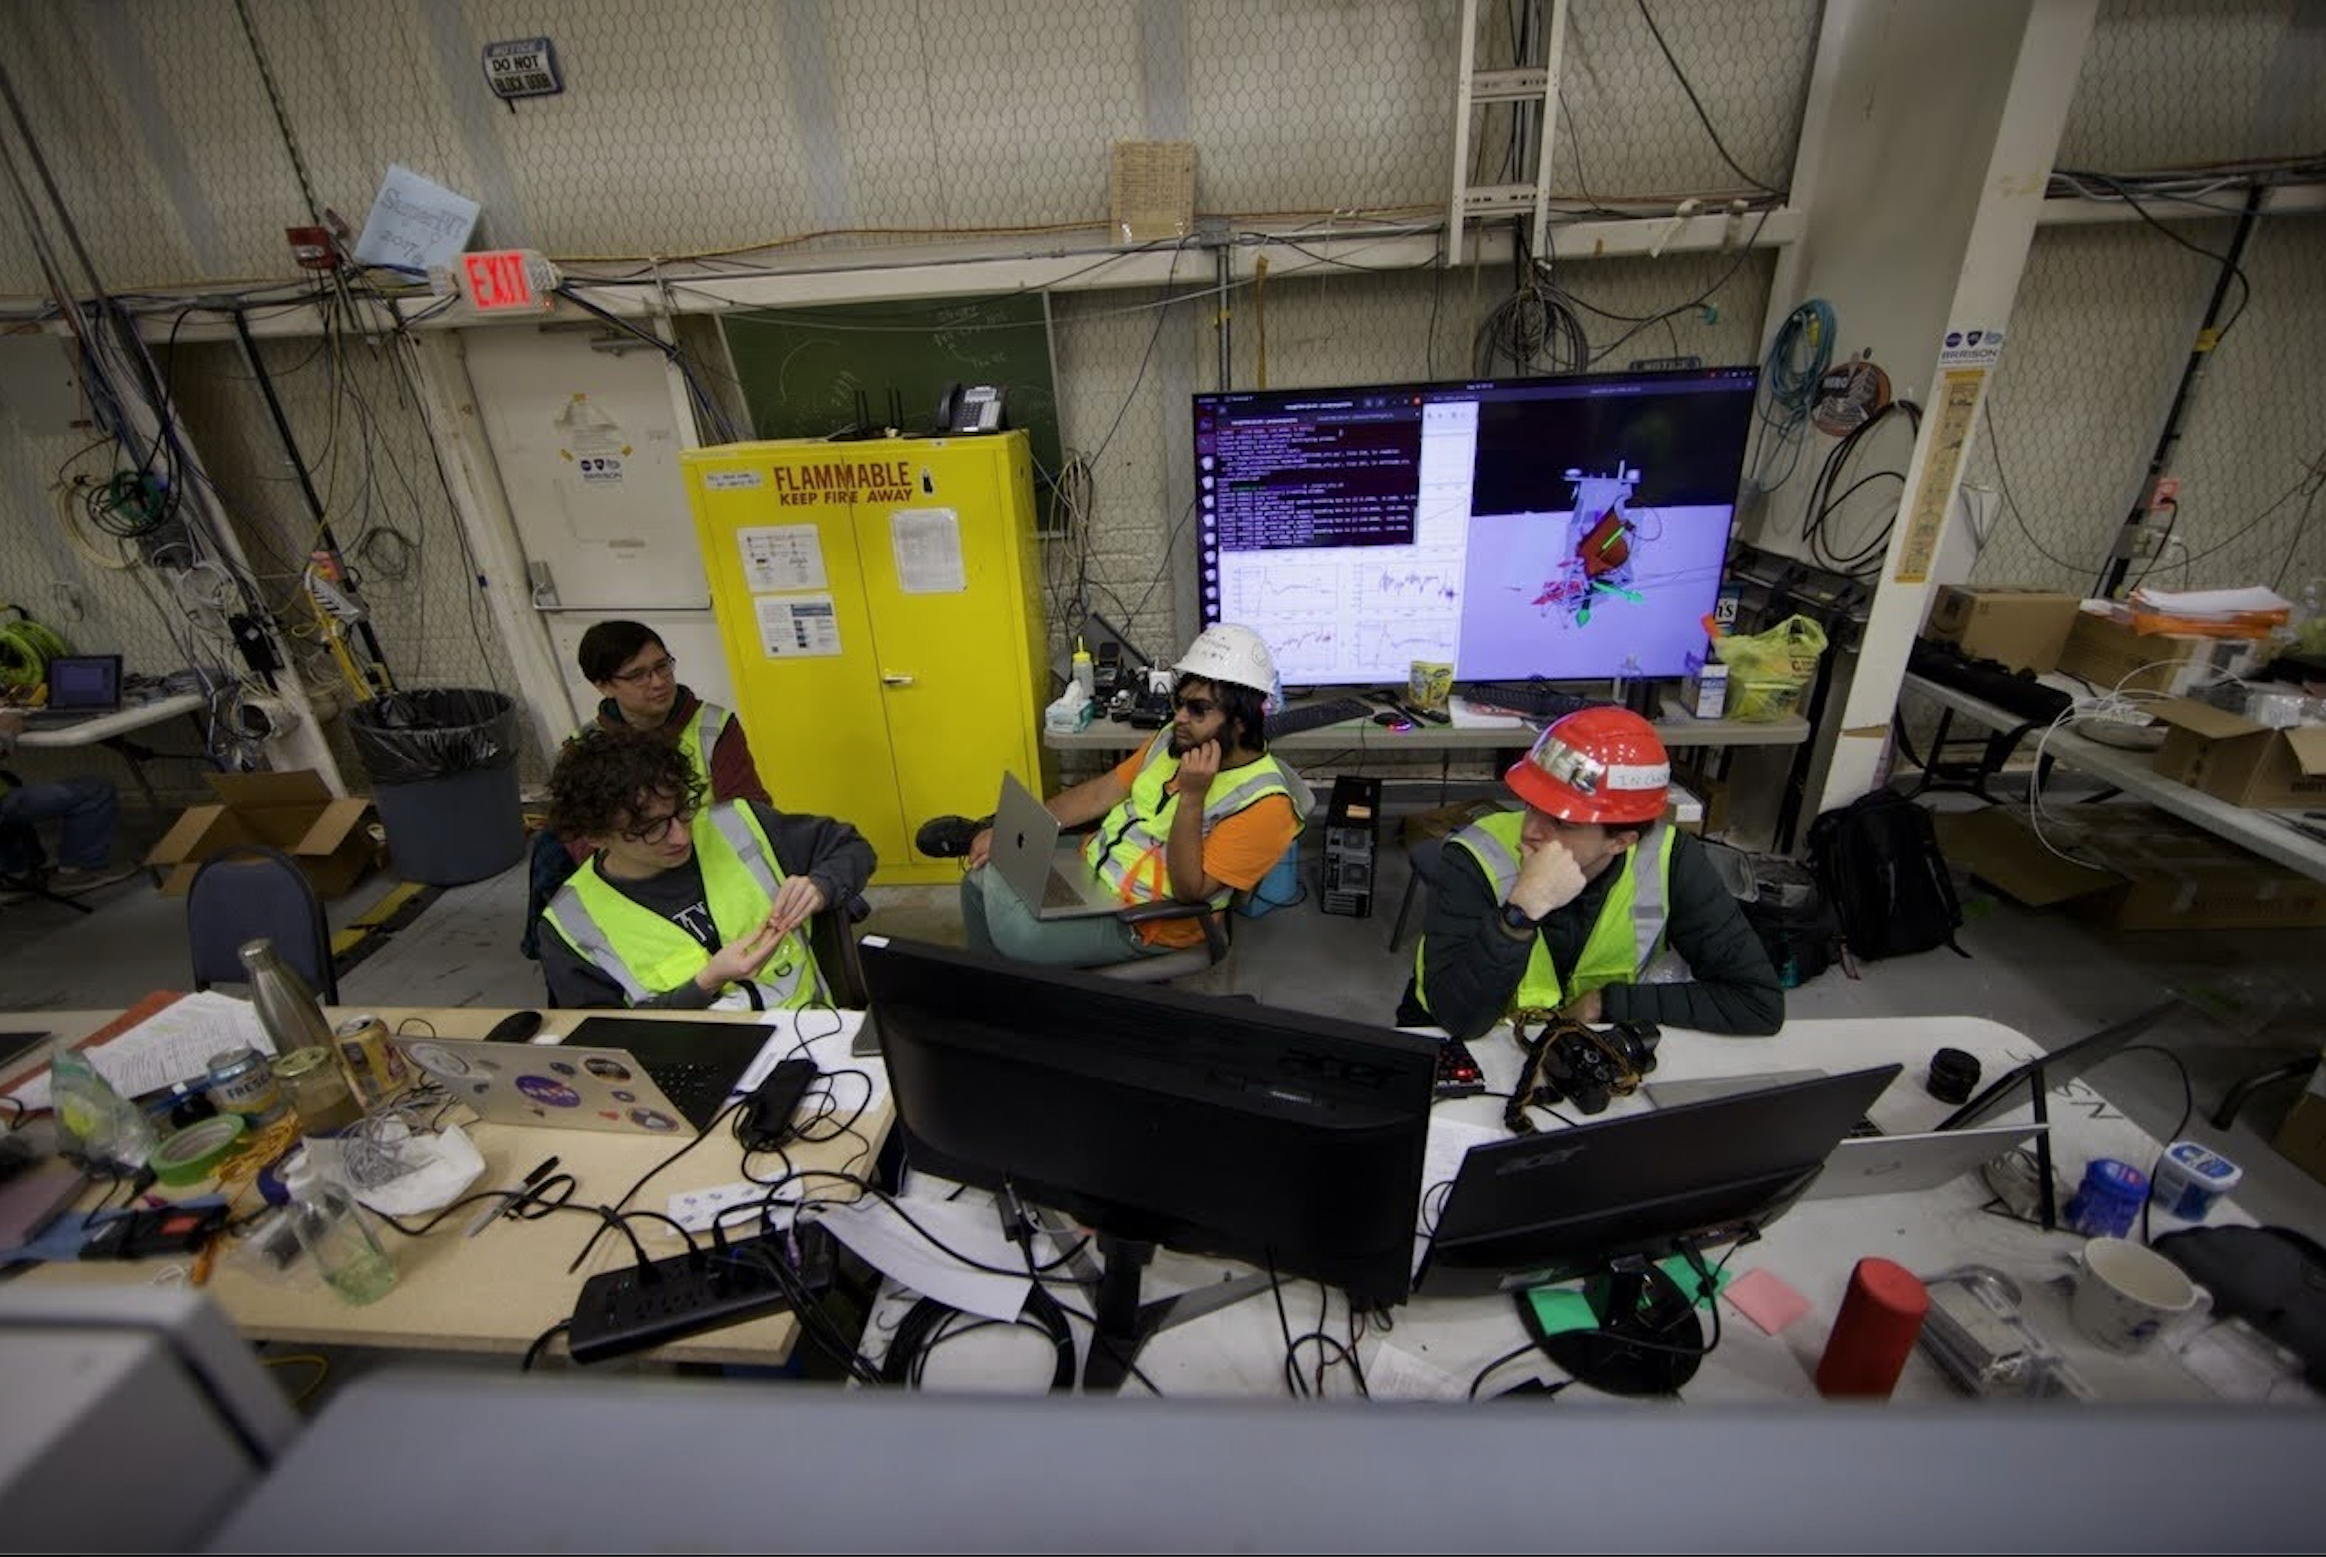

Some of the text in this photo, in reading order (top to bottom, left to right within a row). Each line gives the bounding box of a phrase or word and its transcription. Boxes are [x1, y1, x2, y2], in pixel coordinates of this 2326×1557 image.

[493, 55, 539, 72] DO NOT
[464, 253, 531, 309] EXIT
[773, 461, 912, 492] FLAMMABLE
[779, 488, 914, 506] KEEP FIRE AWAY
